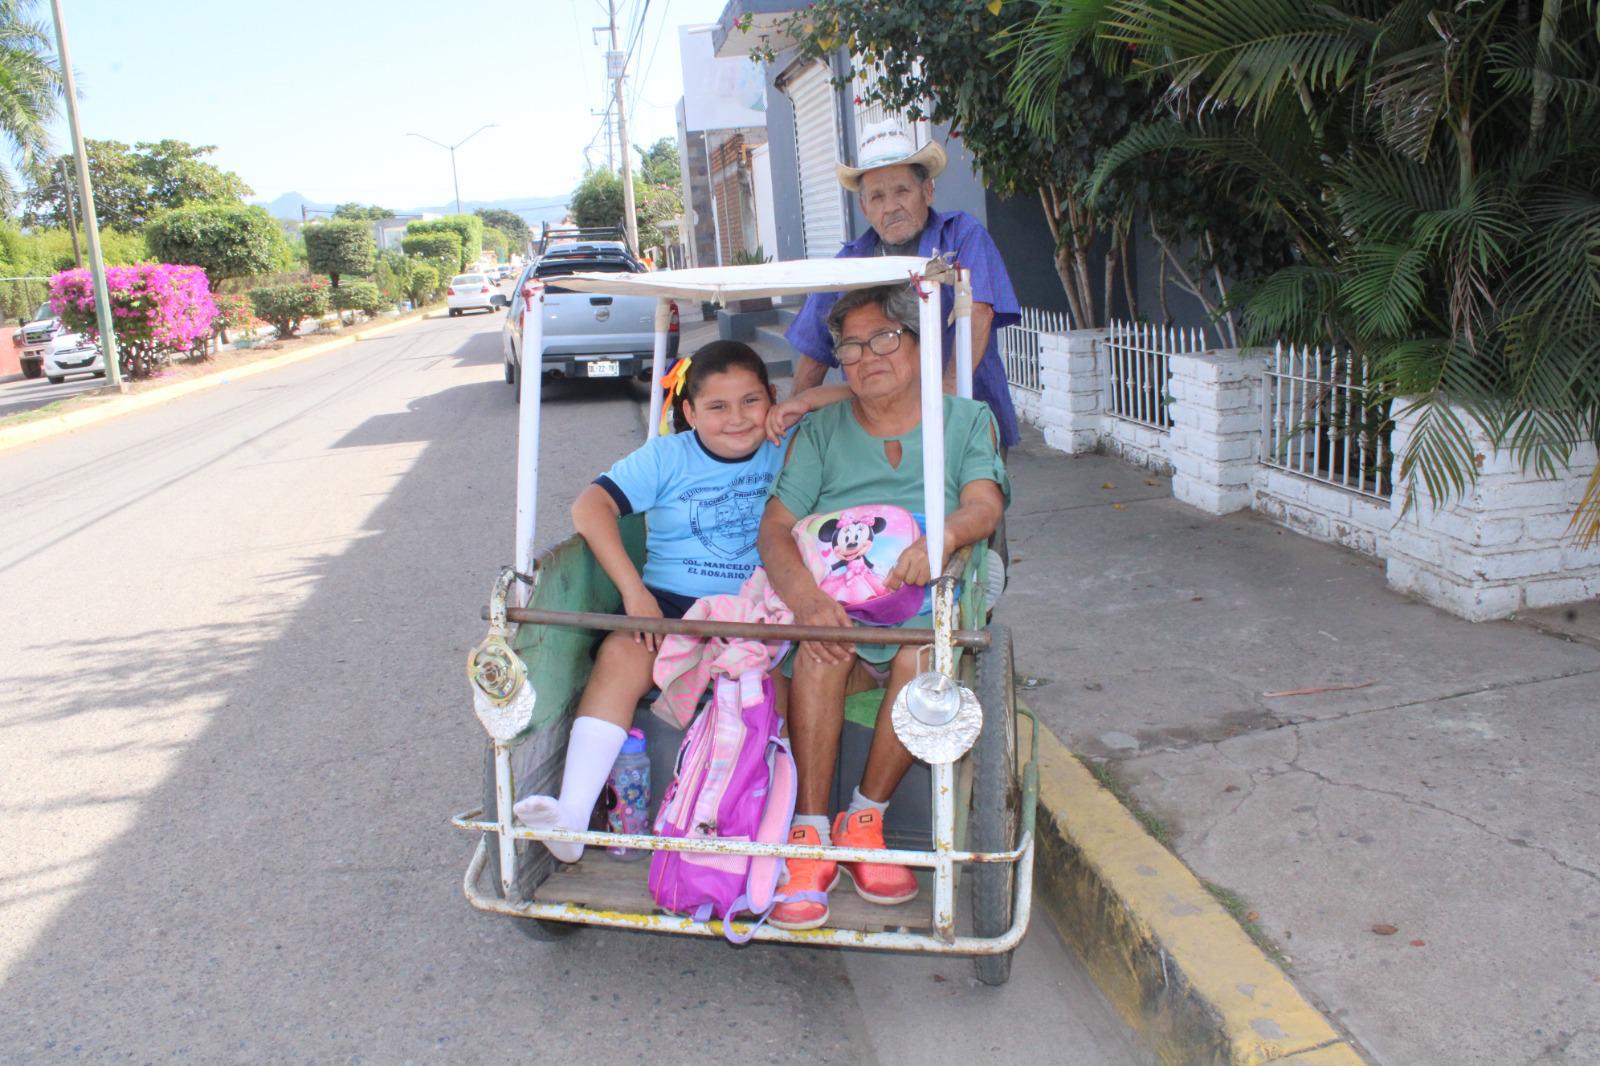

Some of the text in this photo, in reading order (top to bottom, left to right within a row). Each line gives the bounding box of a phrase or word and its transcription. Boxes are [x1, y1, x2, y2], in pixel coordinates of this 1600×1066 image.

[698, 494, 729, 506] ESCUELA
[734, 488, 768, 498] PRIMARIA
[682, 559, 702, 567] COL.
[703, 561, 751, 571] MARCELO
[687, 567, 699, 575] EL
